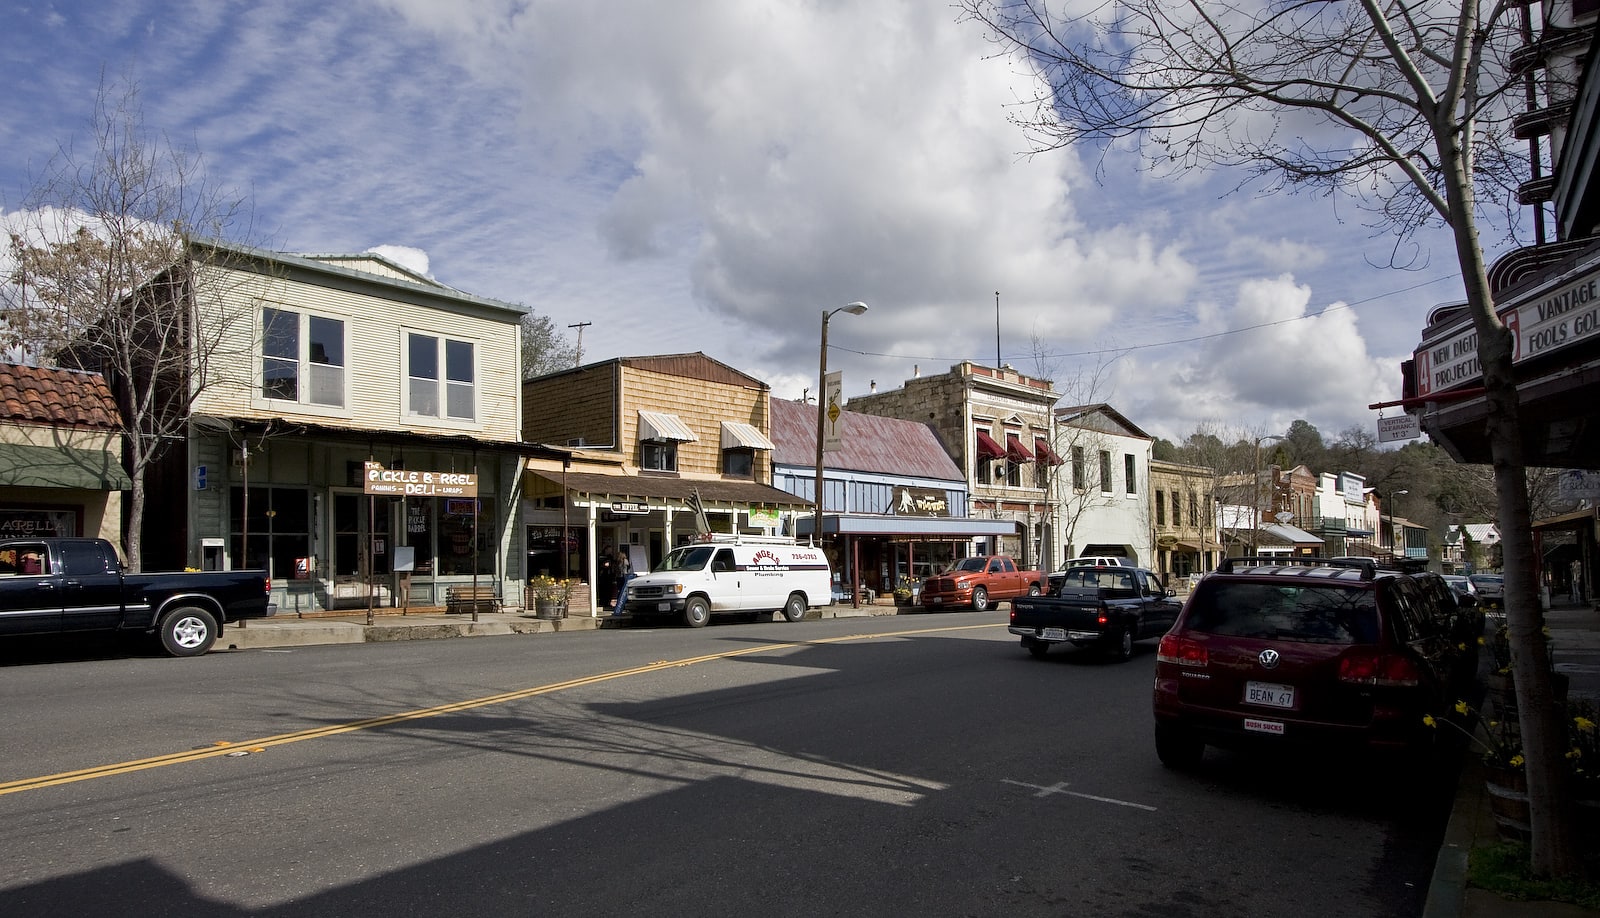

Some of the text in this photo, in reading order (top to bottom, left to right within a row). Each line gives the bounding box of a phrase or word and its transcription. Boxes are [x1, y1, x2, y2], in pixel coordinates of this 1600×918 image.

[1537, 281, 1597, 320] VANTAGE
[1529, 310, 1600, 353] FOOLS GOL
[1433, 332, 1478, 366] NEW DIGIT
[1419, 352, 1429, 393] 4
[1381, 422, 1417, 432] CLEARANCE
[1383, 417, 1412, 426] VERTICAL
[368, 470, 419, 483] PICKLE
[405, 483, 436, 495] DELI
[753, 550, 780, 565] ANGELS
[1250, 689, 1291, 705] BEAN 67
[1246, 721, 1283, 731] BUSH SUCKS
